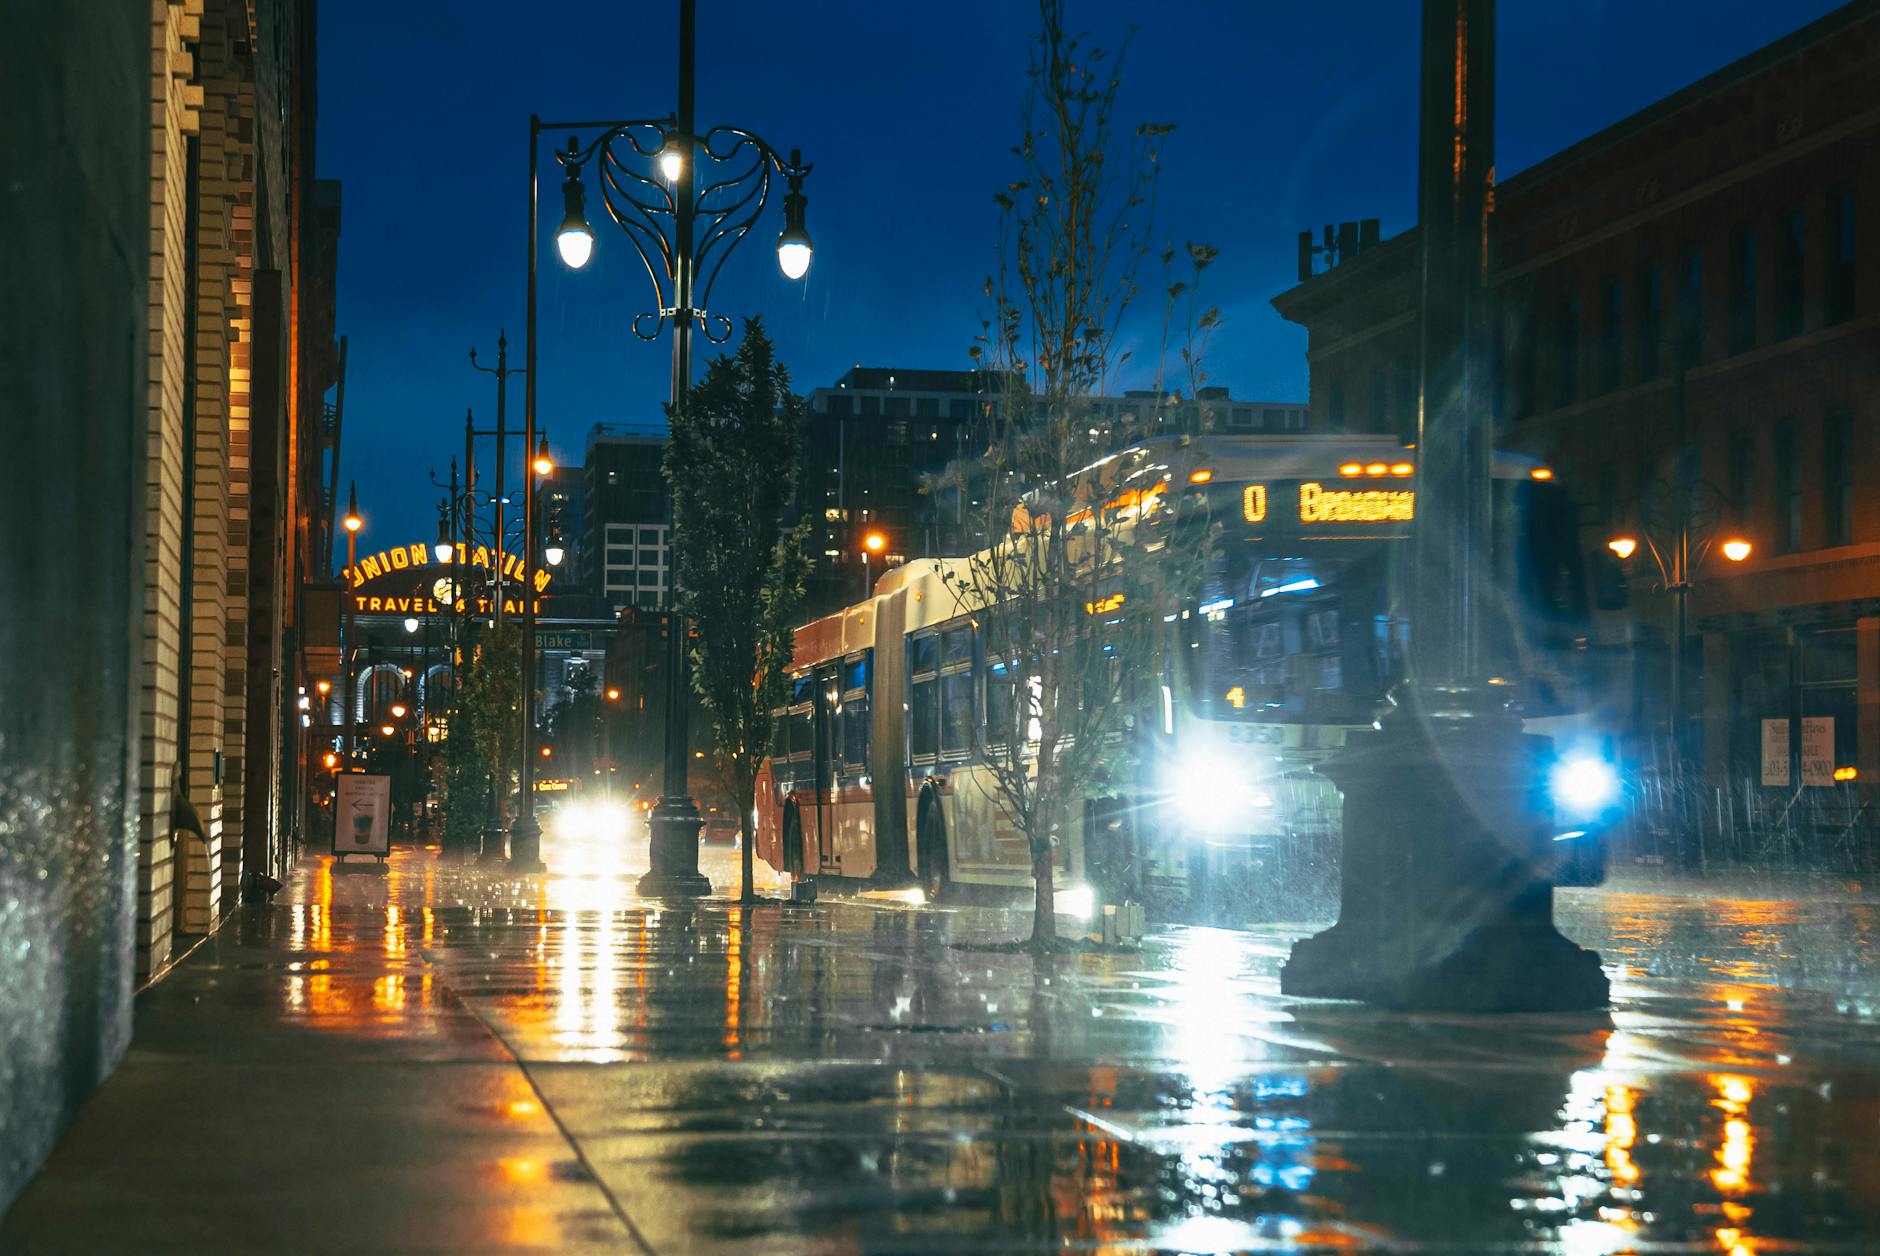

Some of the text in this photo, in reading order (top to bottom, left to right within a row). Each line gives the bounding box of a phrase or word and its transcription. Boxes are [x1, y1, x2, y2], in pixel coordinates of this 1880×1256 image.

[343, 543, 428, 588] UNION
[356, 597, 437, 612] TRAVEL
[535, 635, 572, 648] Blake
